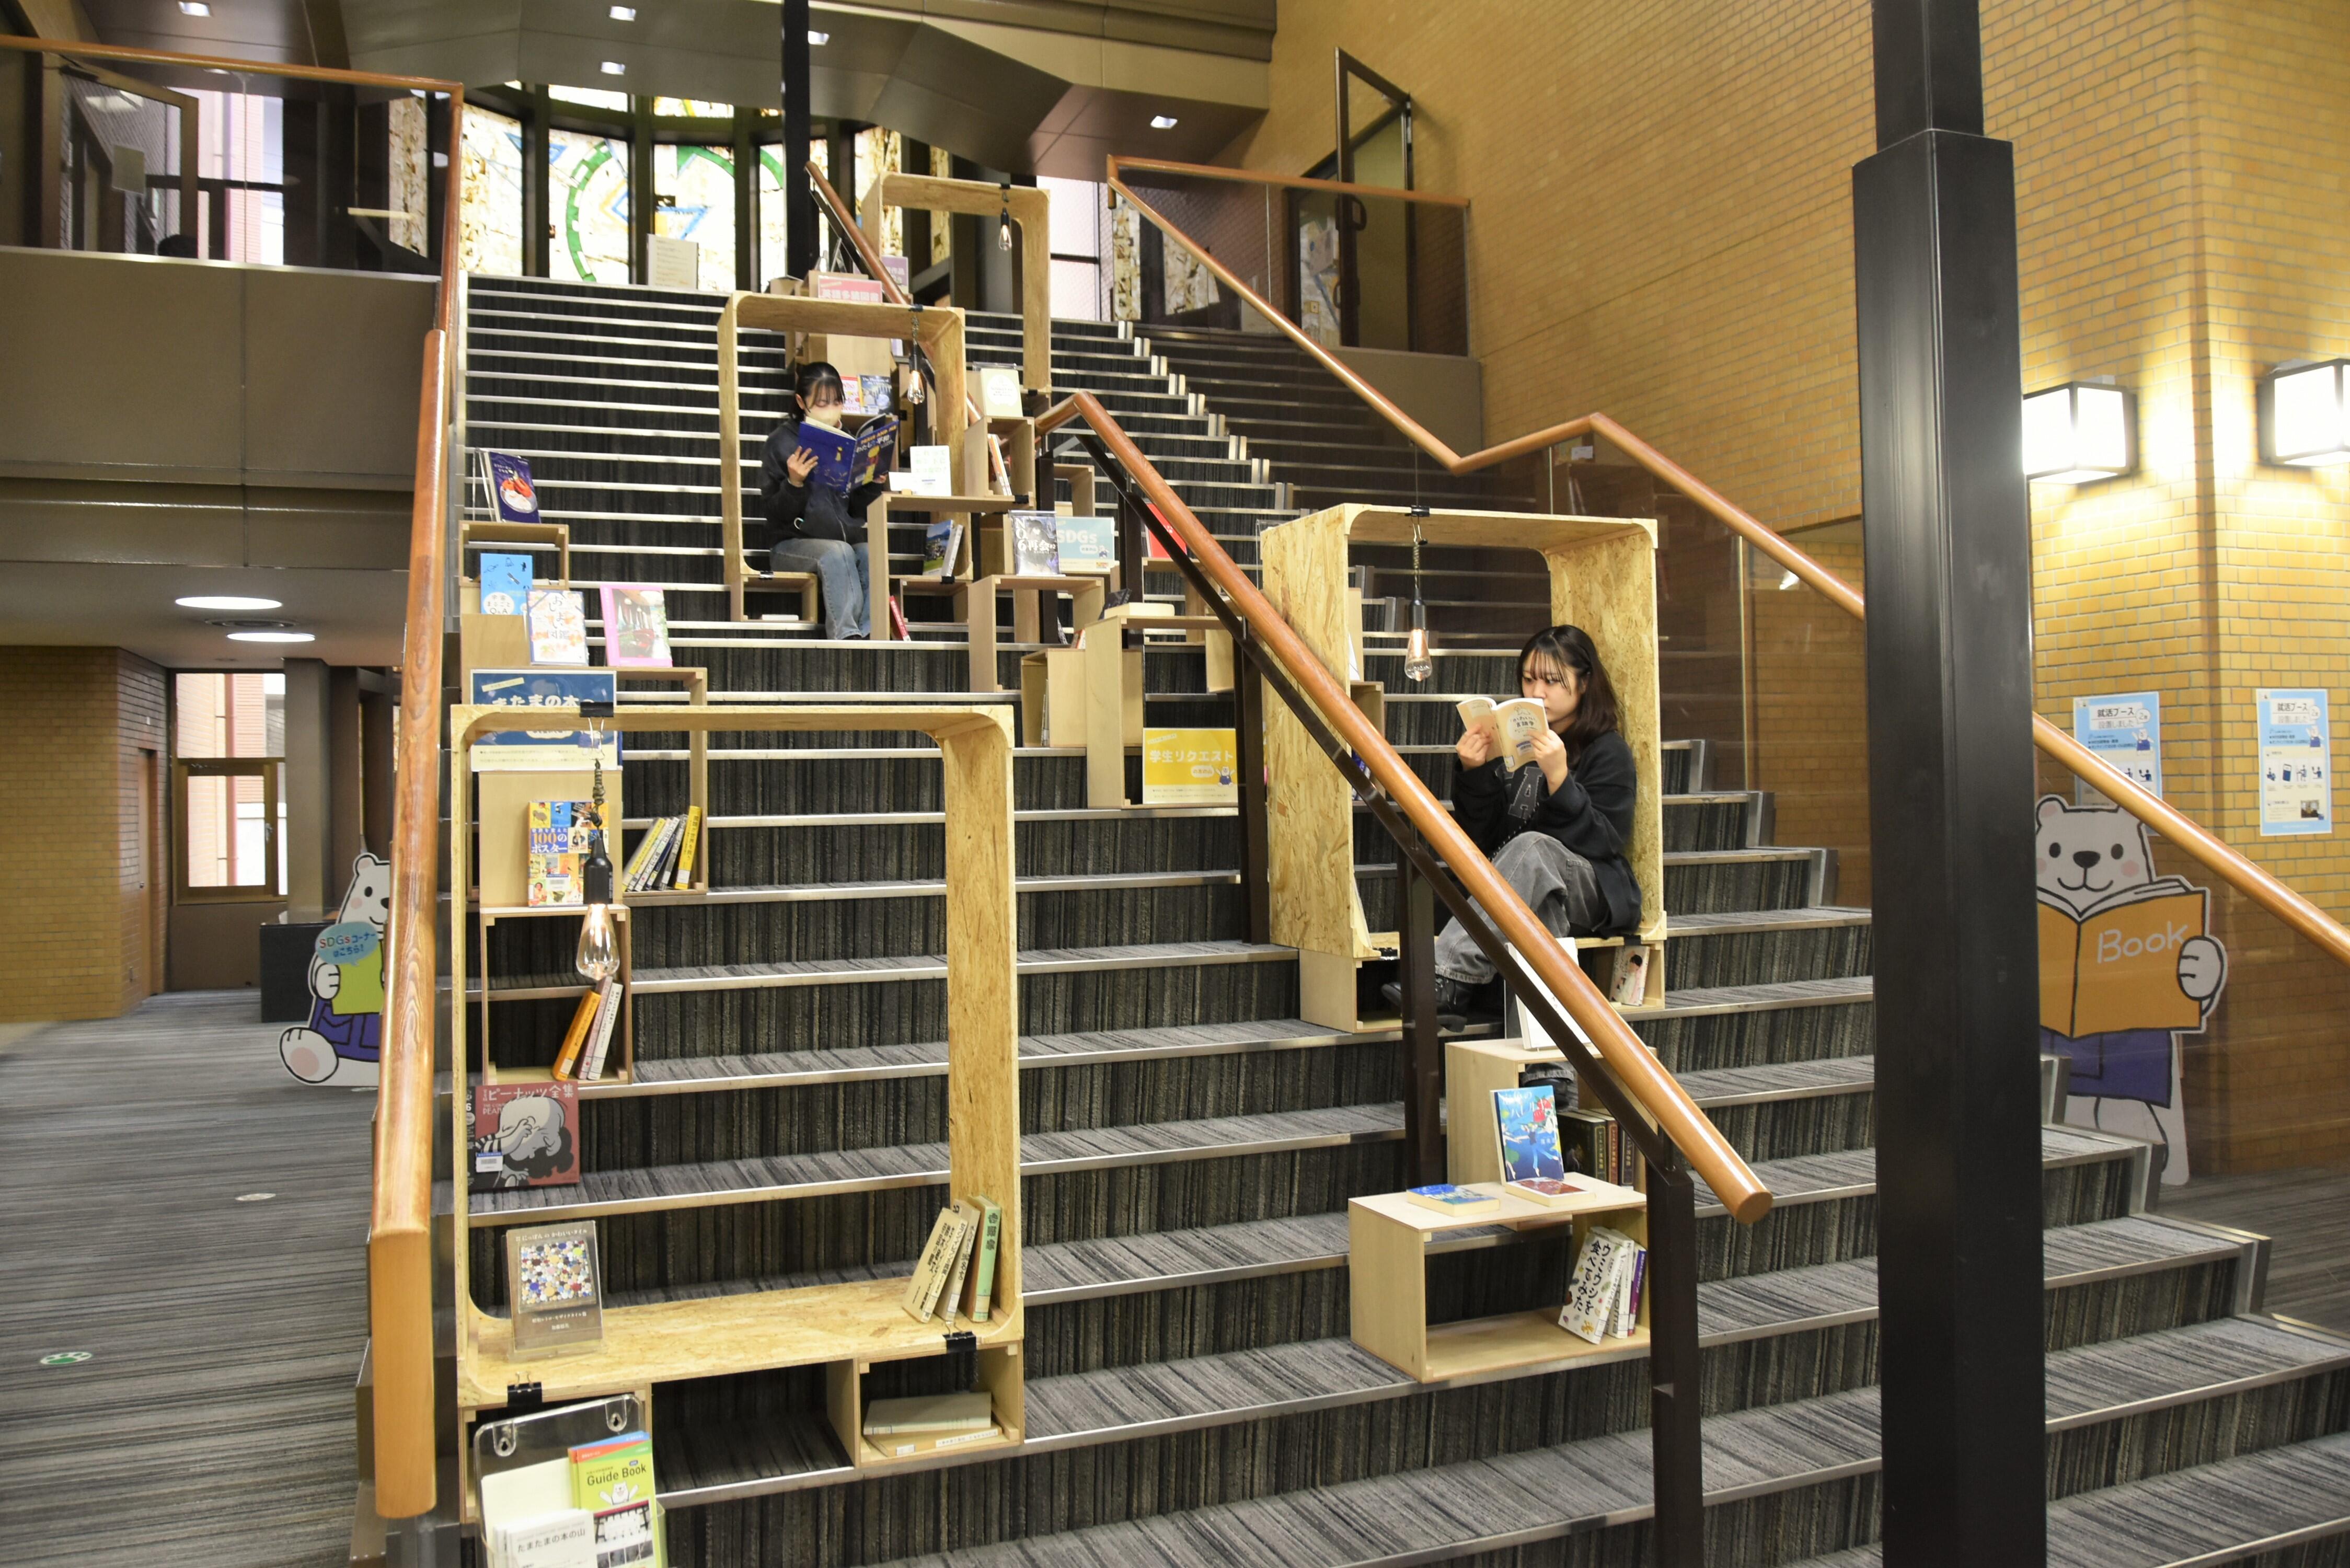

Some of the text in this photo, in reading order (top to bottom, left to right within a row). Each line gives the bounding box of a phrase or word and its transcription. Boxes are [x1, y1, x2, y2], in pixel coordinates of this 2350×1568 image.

[1057, 529, 1098, 544] SDGs
[2098, 707, 2135, 718] 就活ブース
[2277, 703, 2308, 711] 就活ブース
[2098, 719, 2135, 729] 設置しました
[1149, 750, 1234, 763] 学生リクエスト
[533, 833, 568, 844] 100の
[532, 844, 568, 854] ポスター
[319, 932, 376, 949] SDGsコーナー
[2097, 920, 2188, 964] Book
[333, 943, 364, 958] はこちら!
[489, 1083, 574, 1101] ピーナッツ全集
[1573, 1240, 1602, 1311] 食べてみた
[1584, 1243, 1611, 1316] ウミウシを
[587, 1472, 619, 1486] Guide
[622, 1464, 647, 1477] Book
[517, 1528, 585, 1553] たまたまの本の山
